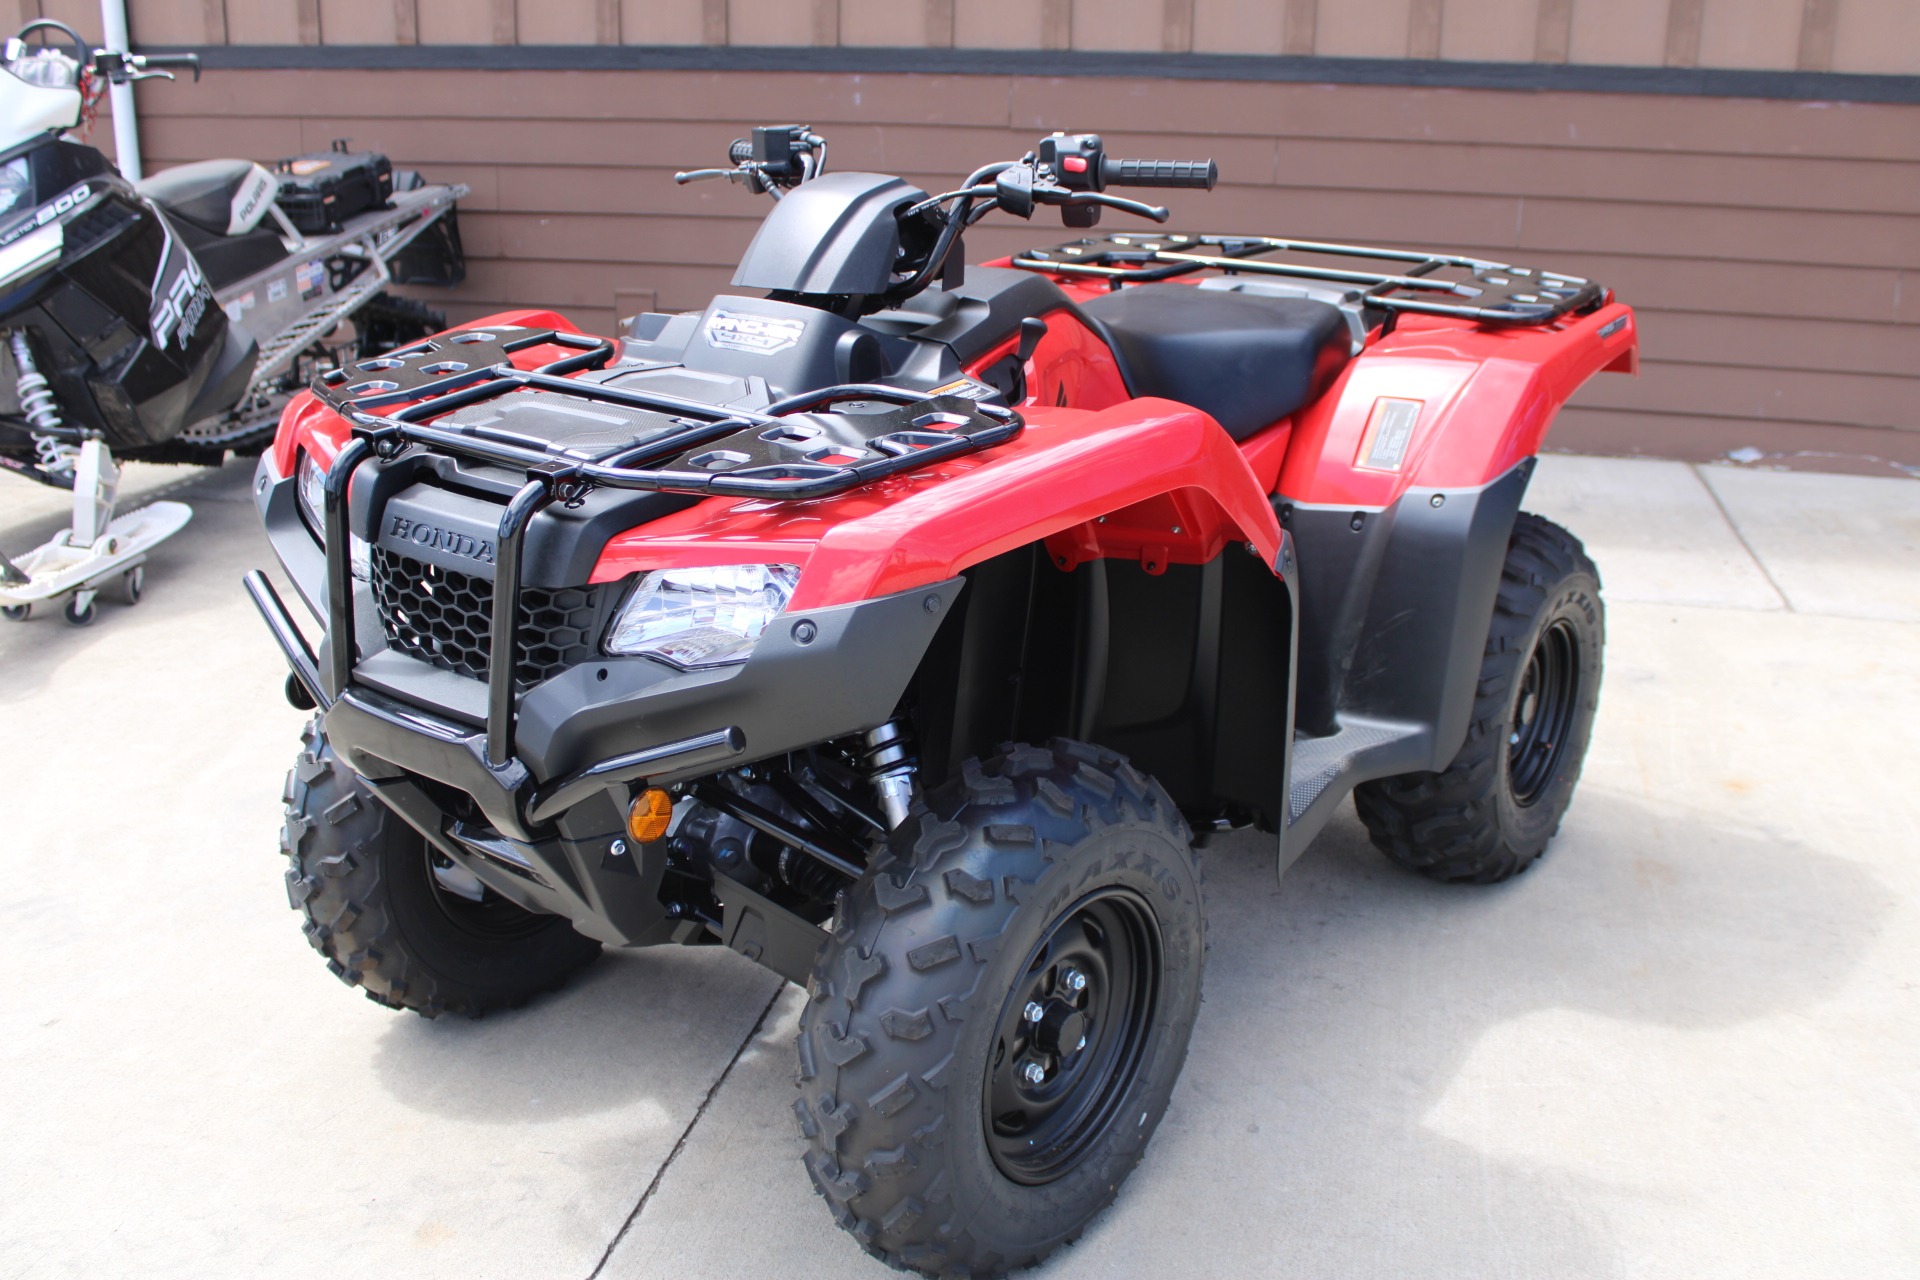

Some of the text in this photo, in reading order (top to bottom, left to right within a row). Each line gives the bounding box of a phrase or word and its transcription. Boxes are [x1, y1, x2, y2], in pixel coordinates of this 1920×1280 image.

[36, 184, 90, 226] 800
[239, 177, 268, 222] POLARIS
[390, 516, 495, 565] HONDA
